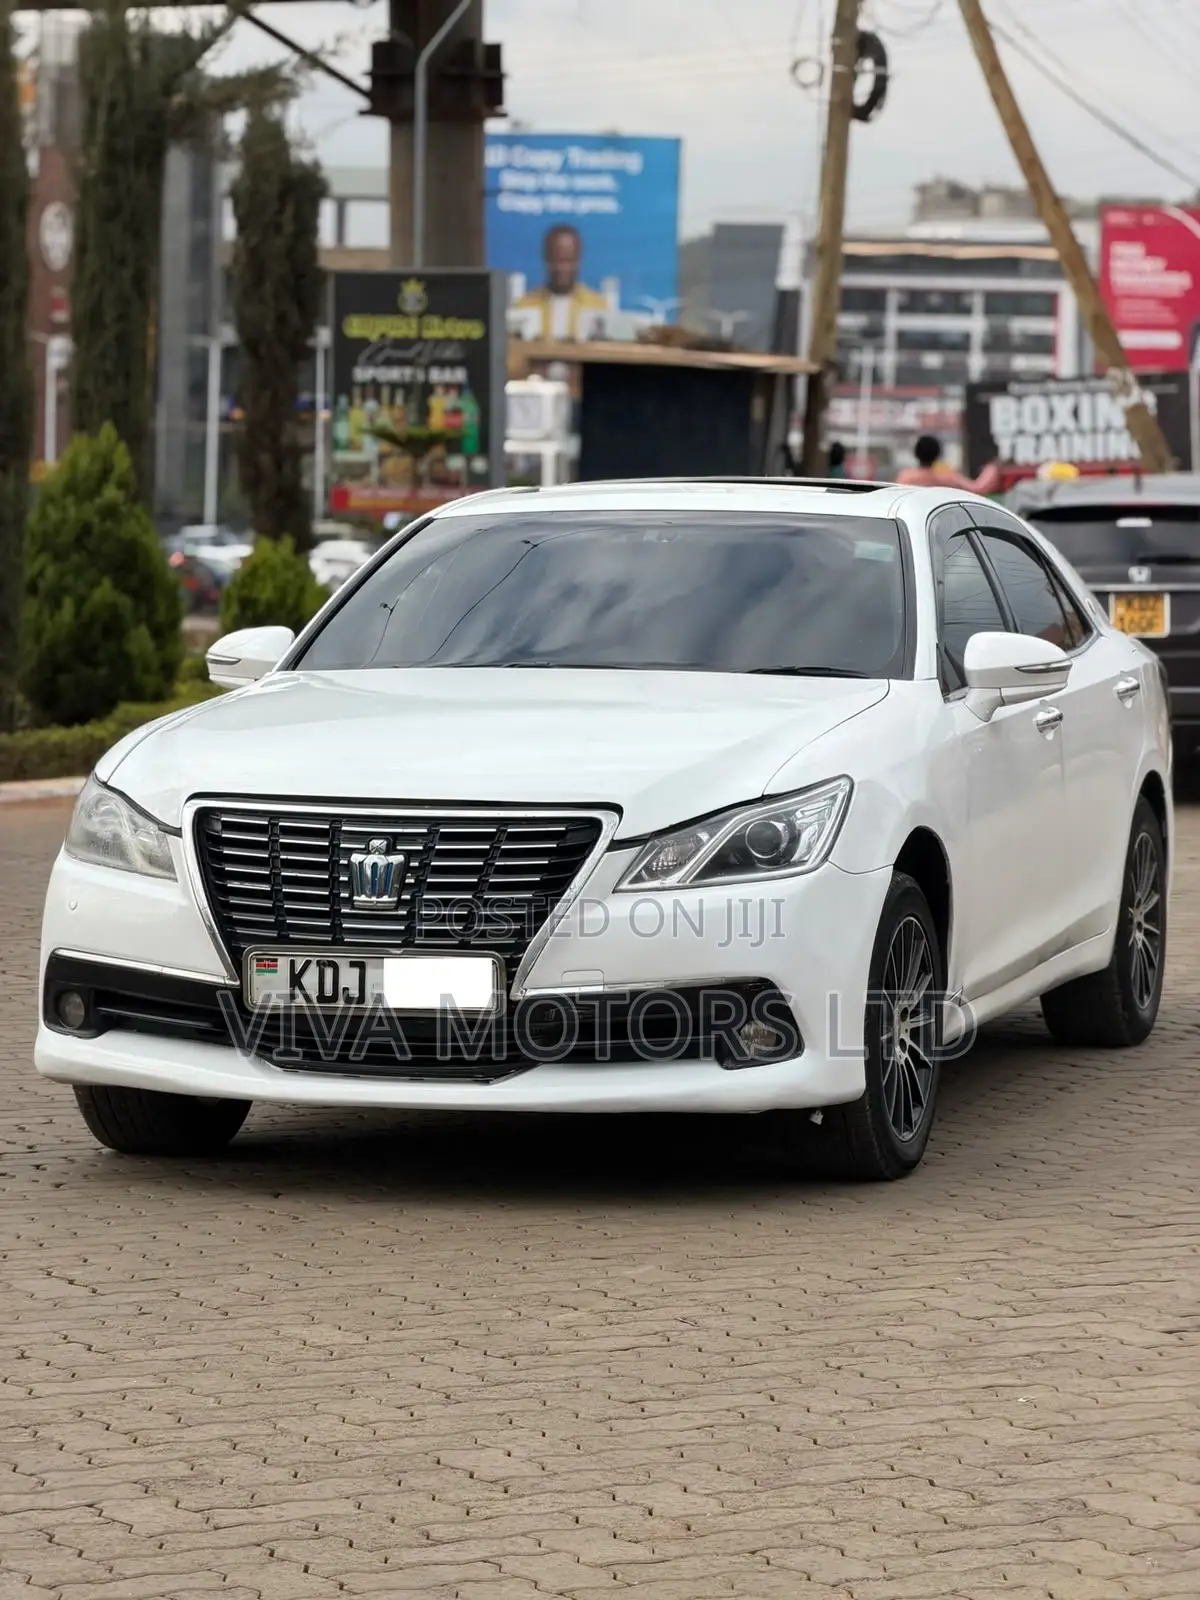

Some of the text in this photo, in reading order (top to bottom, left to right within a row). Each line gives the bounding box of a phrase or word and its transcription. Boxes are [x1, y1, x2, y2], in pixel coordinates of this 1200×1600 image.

[990, 394, 1126, 434] BOXIN
[997, 430, 1141, 465] TRAININ
[289, 958, 367, 1005] KDJ
